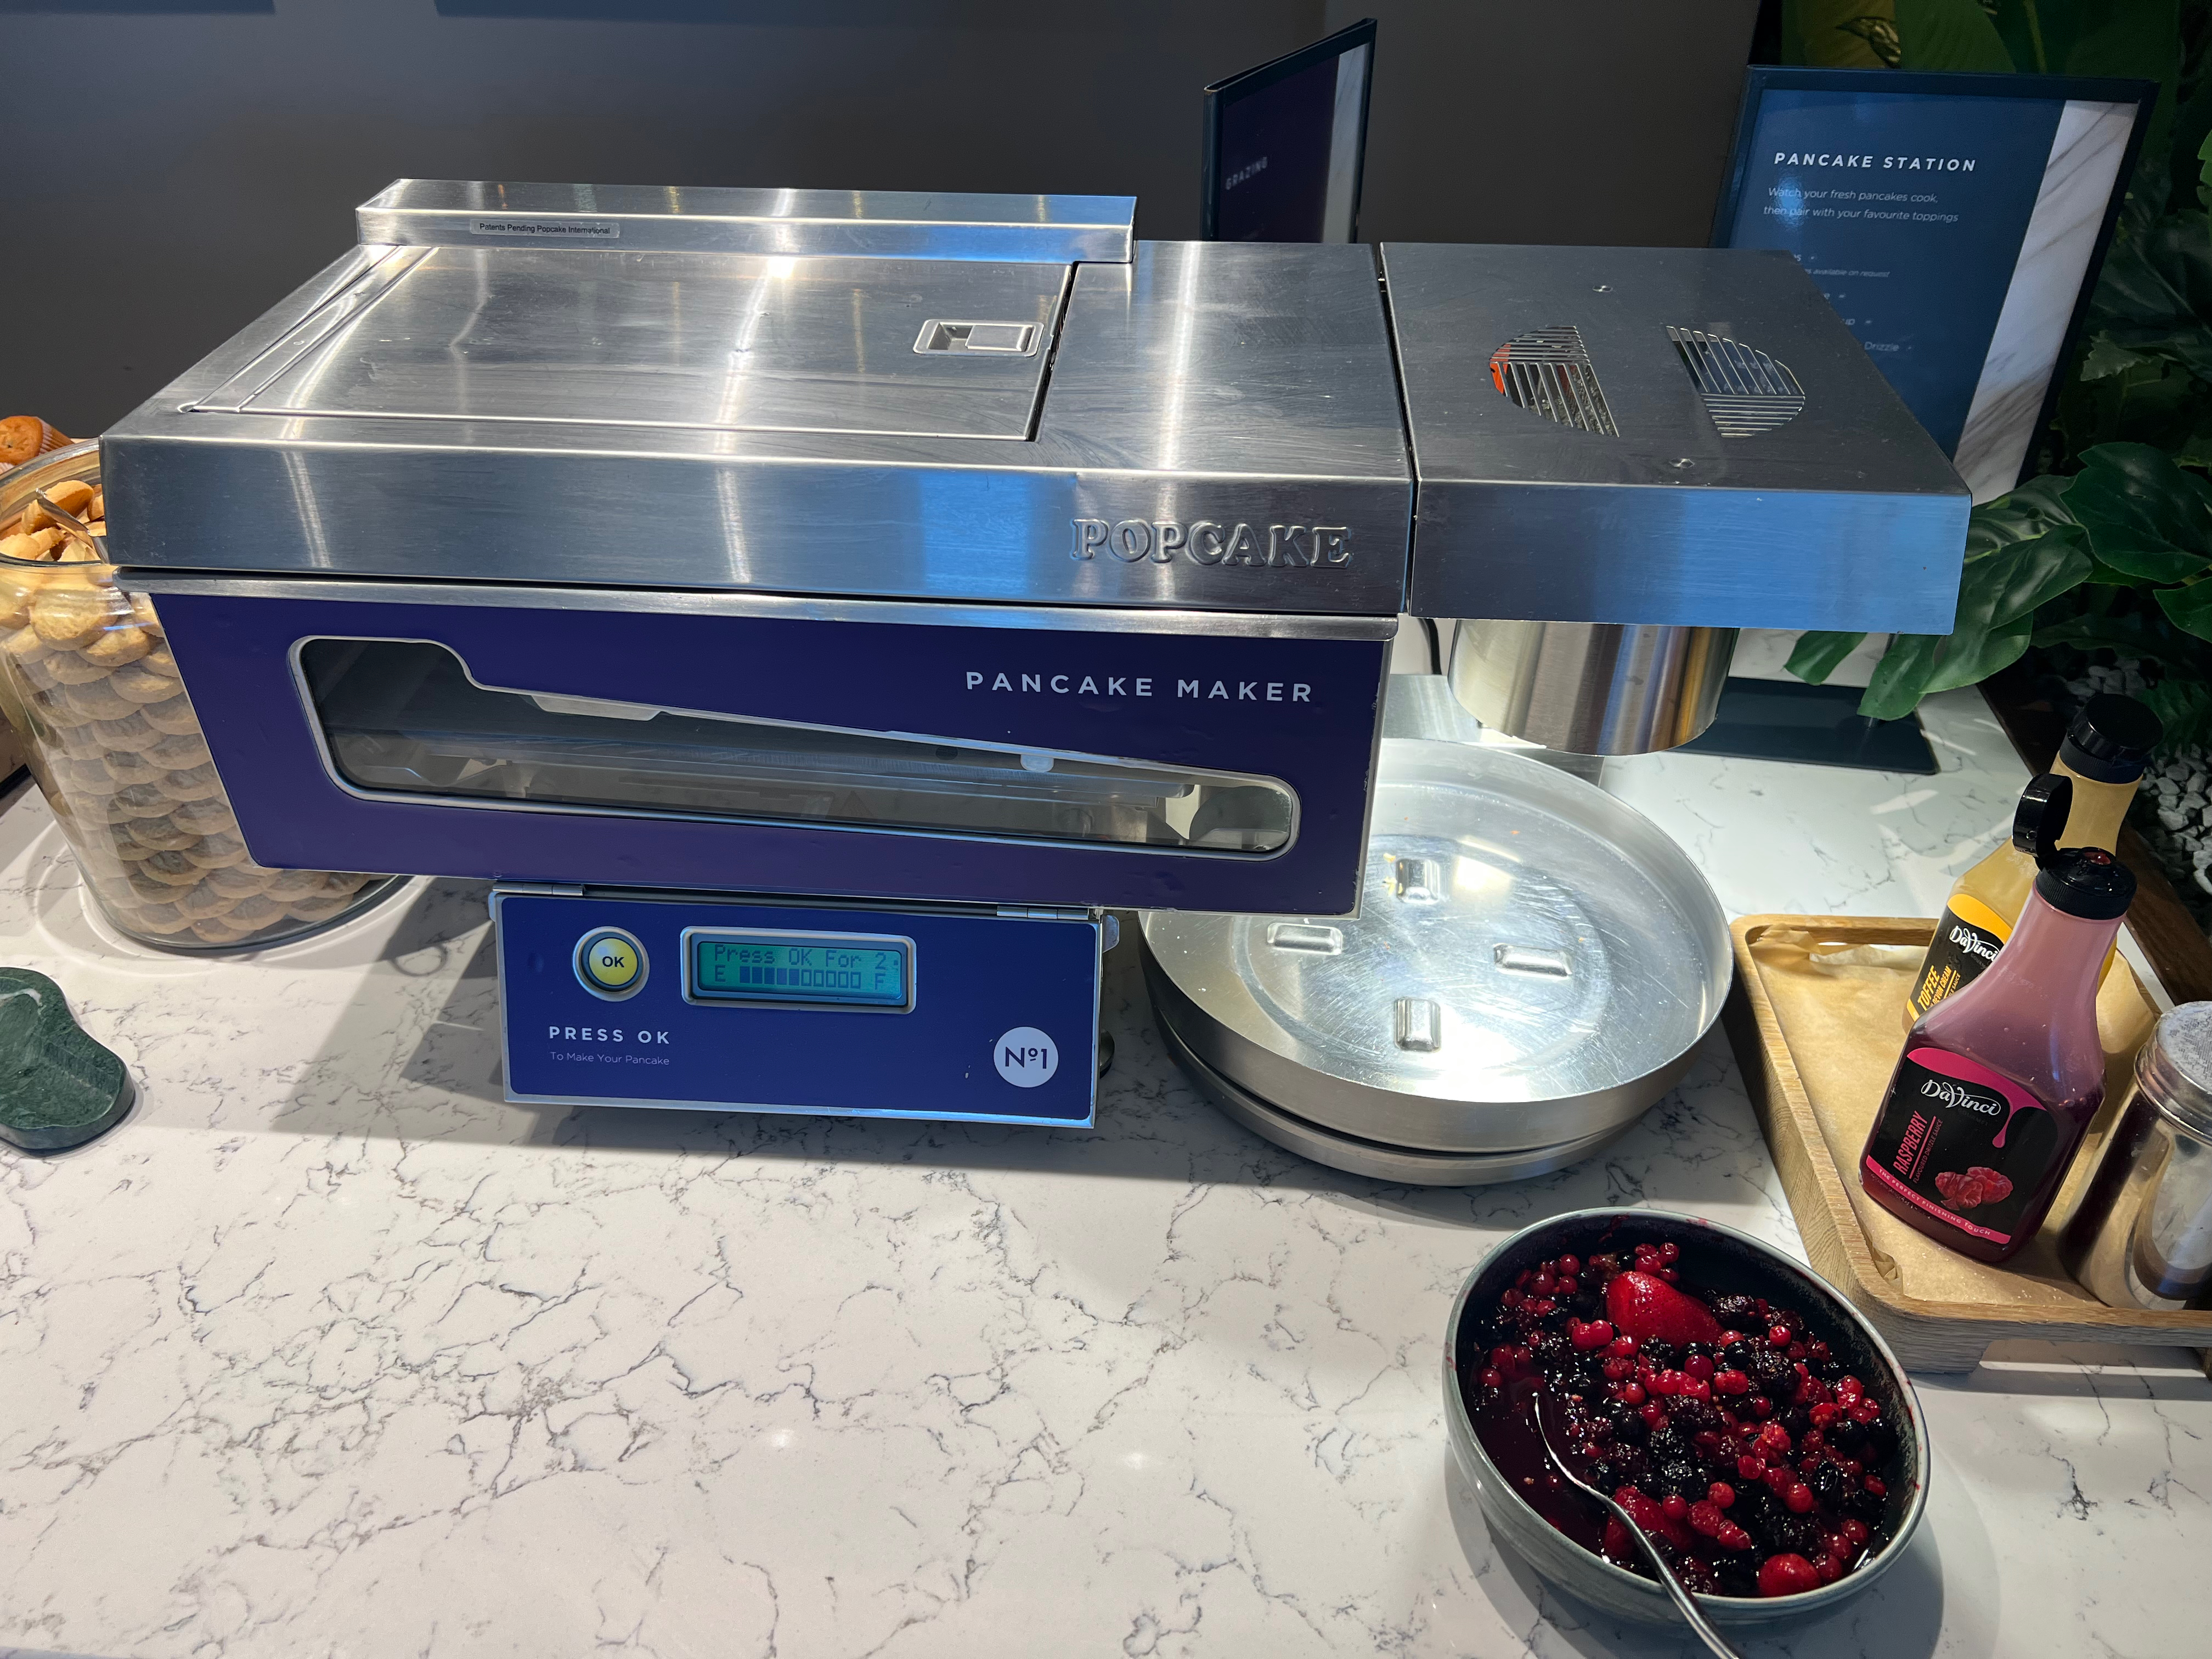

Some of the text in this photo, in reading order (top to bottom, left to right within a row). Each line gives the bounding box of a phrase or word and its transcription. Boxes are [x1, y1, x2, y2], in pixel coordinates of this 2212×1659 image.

[1774, 153, 1976, 172] PANCAKE STATION
[1768, 188, 1939, 205] Watch your fresh pancakes cook,
[1763, 206, 1959, 223] then pair with your favourite toppings
[479, 222, 610, 234] Patents Pending Popcake International
[1864, 341, 1900, 352] Drizzle
[1070, 518, 1353, 568] POPCAKE
[966, 671, 1311, 702] PANCAKE MAKER
[1949, 925, 2001, 962] DaVinci
[602, 956, 624, 968] OK
[714, 944, 776, 964] Press
[788, 947, 812, 966] OK
[826, 950, 862, 968] For
[715, 964, 887, 990] E F
[1917, 964, 1941, 1011] TOFFEE
[1940, 964, 1953, 988] CREAM
[1951, 972, 1961, 990] SAUCE
[549, 1026, 670, 1045] PRESS OK
[550, 1051, 670, 1065] To Make Your Pancake
[1921, 1079, 2001, 1116] DaVinci
[1892, 1110, 1927, 1175] RASPBERRY
[1912, 1118, 1943, 1183] FLAVOURED DRIZZLE SAUCE
[1878, 1168, 1991, 1236] THE PERFECT FINISHING TOUCH
